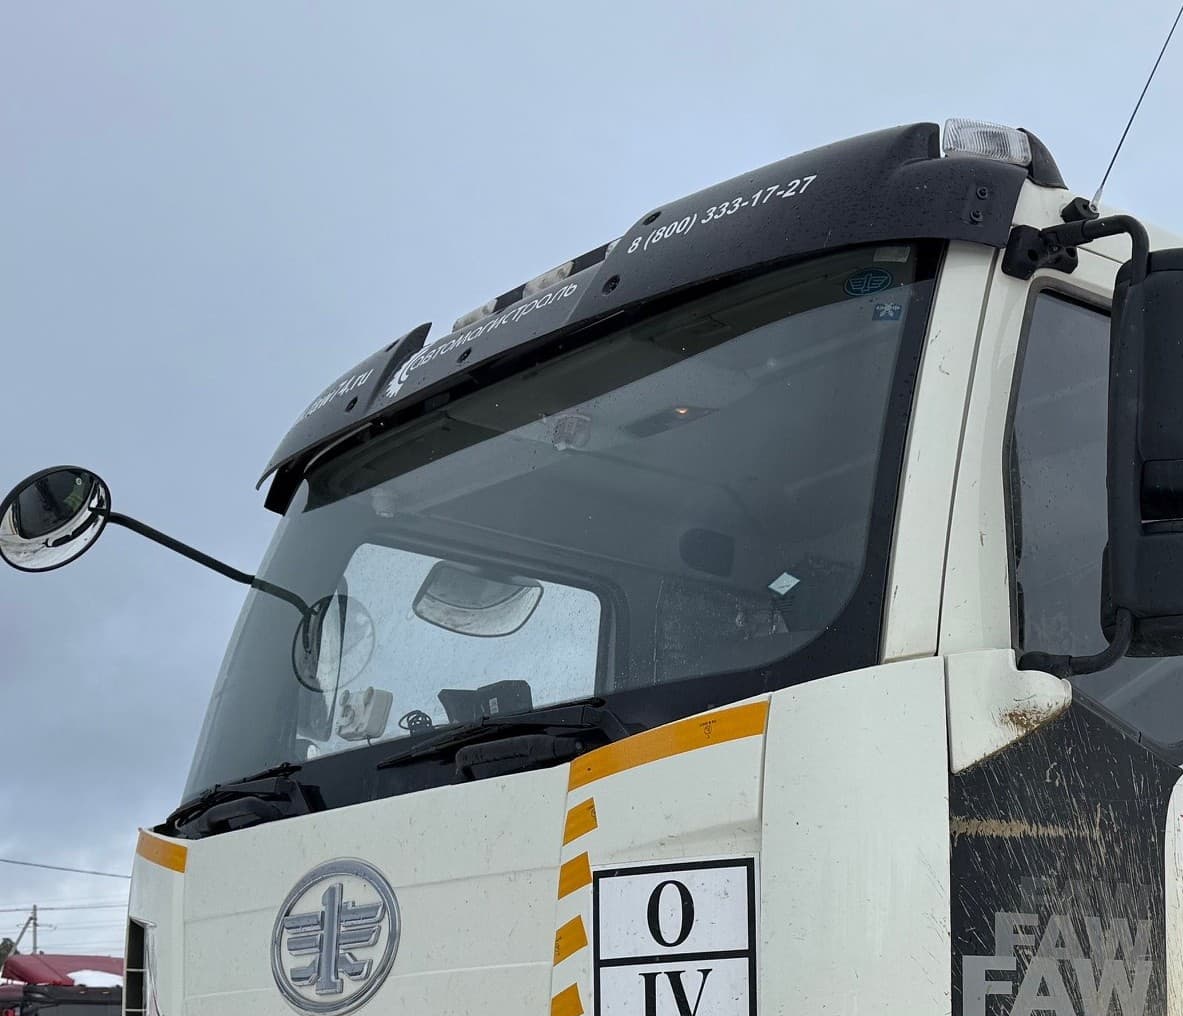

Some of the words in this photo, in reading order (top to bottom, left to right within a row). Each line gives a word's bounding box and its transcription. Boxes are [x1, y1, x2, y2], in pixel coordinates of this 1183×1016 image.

[627, 236, 643, 255] 8
[643, 213, 698, 251] (800)
[700, 174, 817, 225] 333-17-27
[994, 911, 1153, 959] FAW
